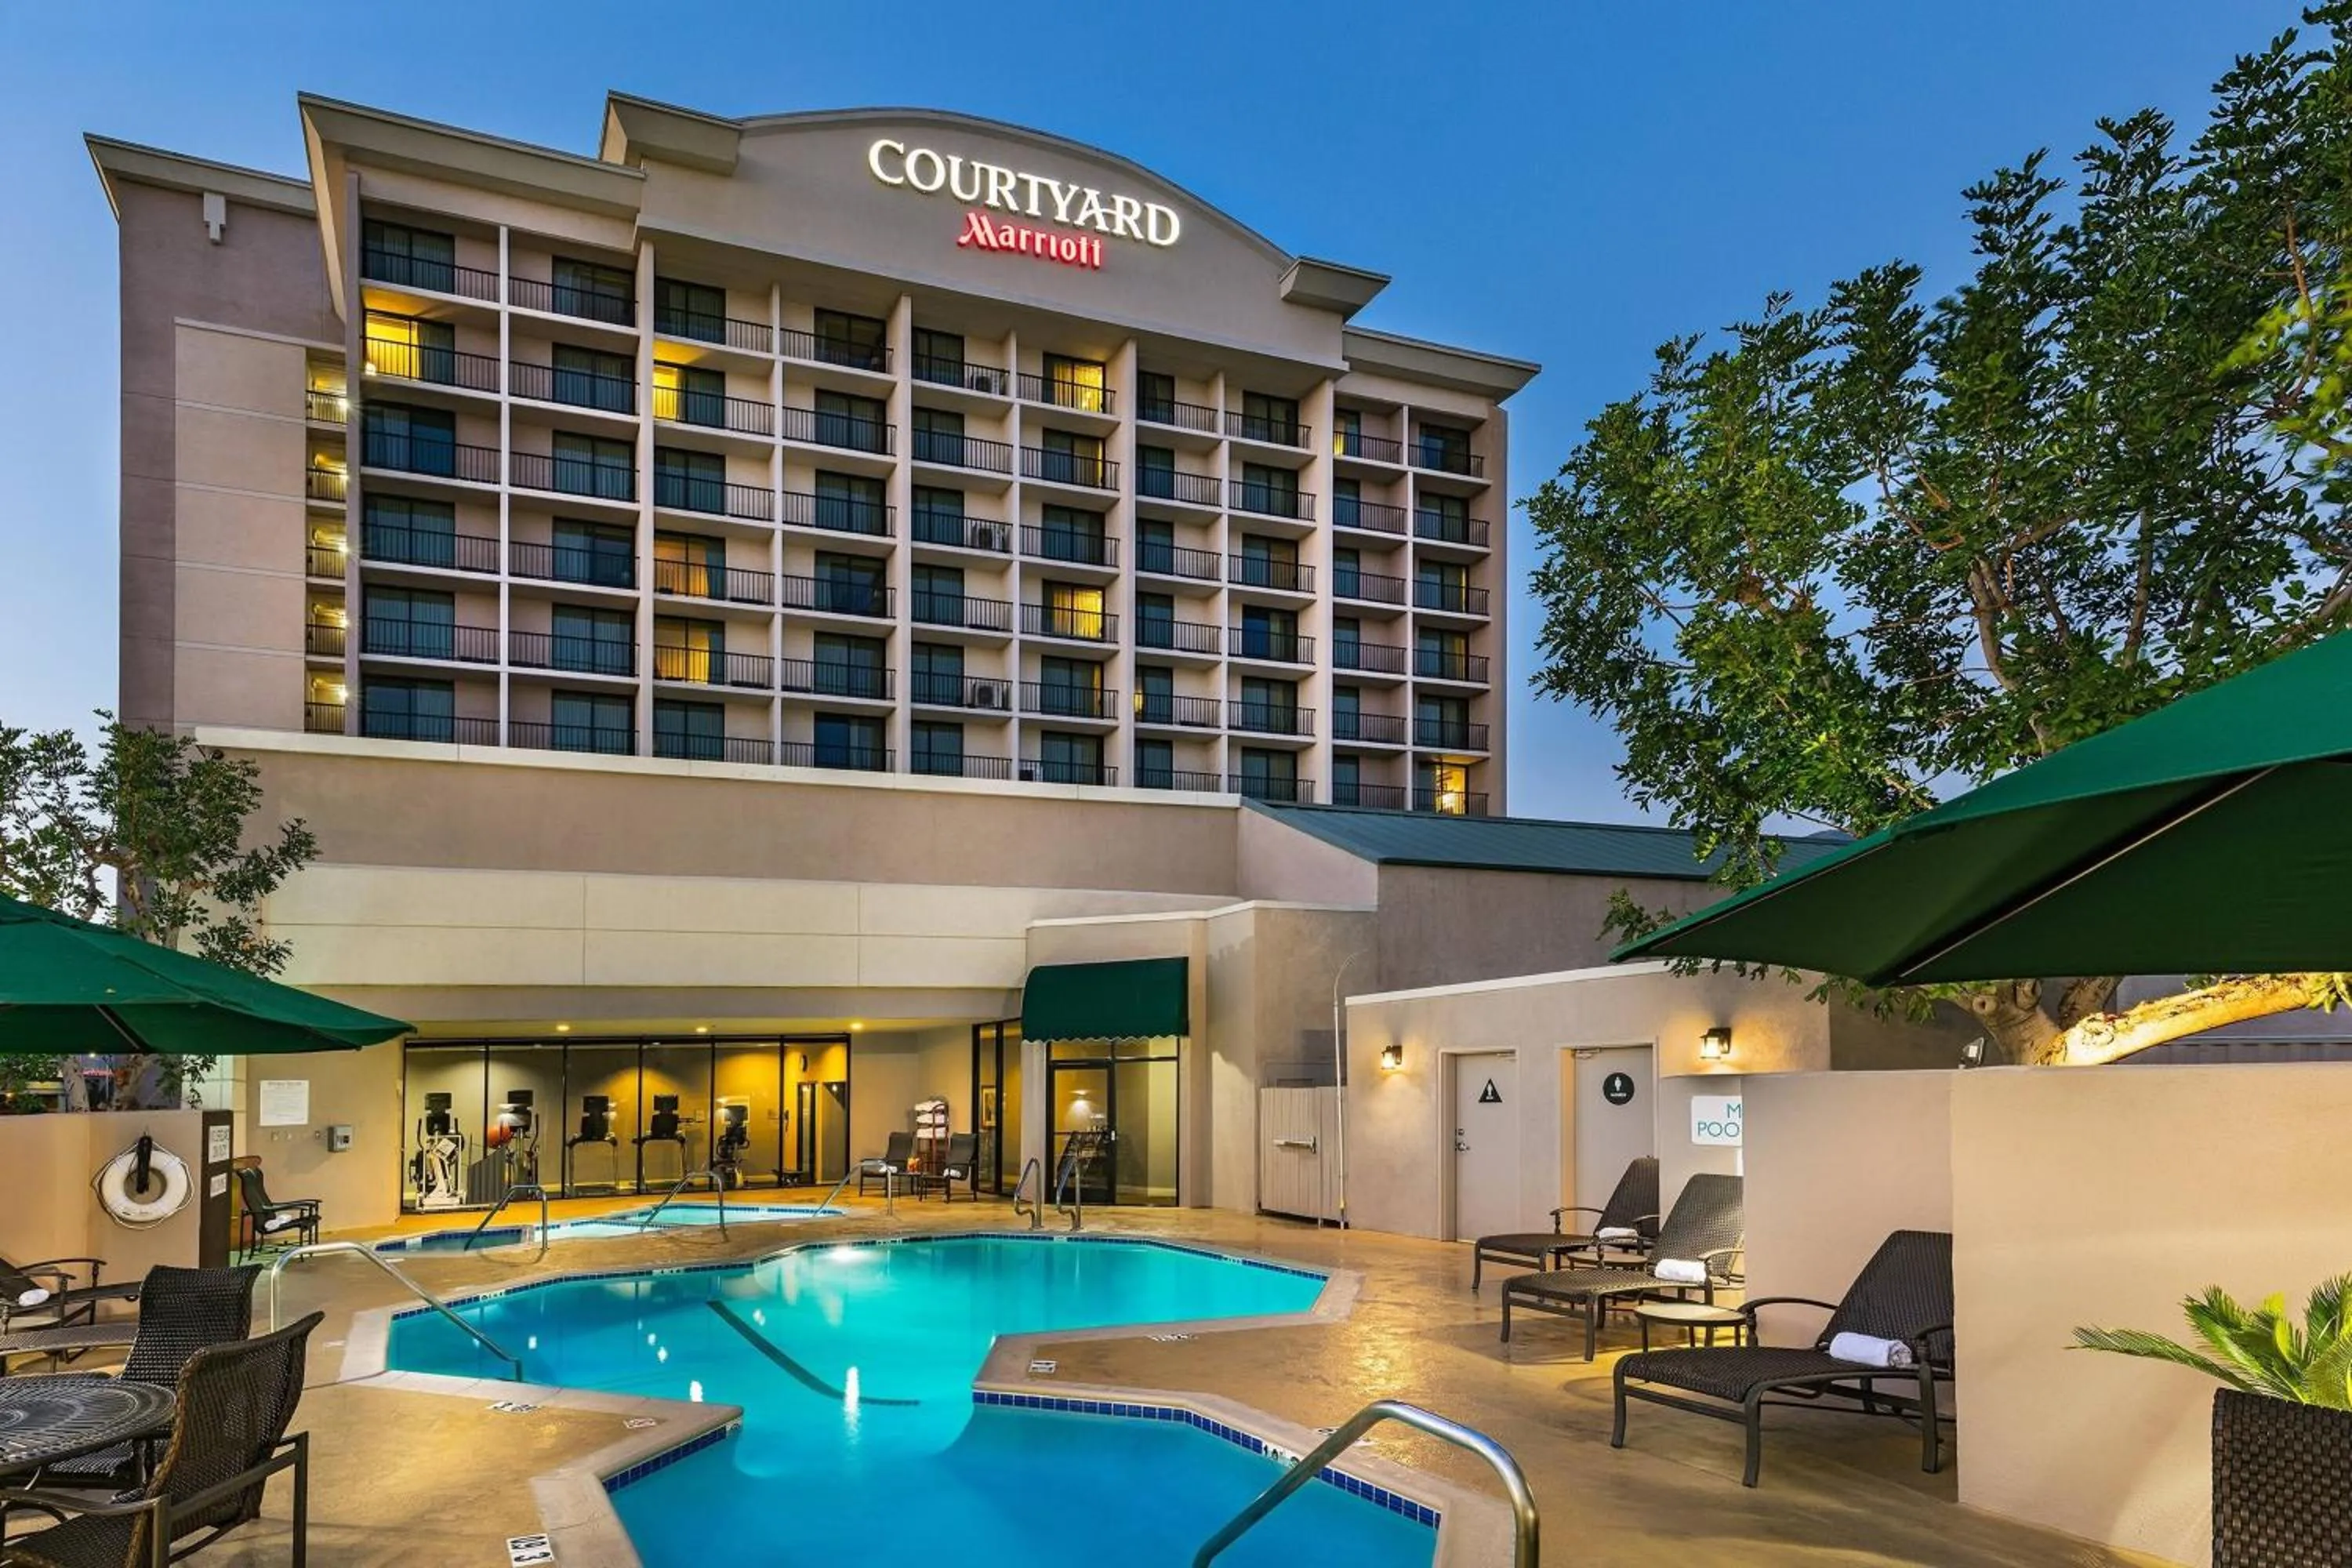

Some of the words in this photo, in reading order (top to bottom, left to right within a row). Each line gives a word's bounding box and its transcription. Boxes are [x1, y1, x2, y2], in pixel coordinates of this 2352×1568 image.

[868, 138, 1181, 246] COURTYARD
[956, 212, 1103, 269] Marriott
[1726, 1103, 1741, 1118] M
[1697, 1121, 1740, 1138] POO
